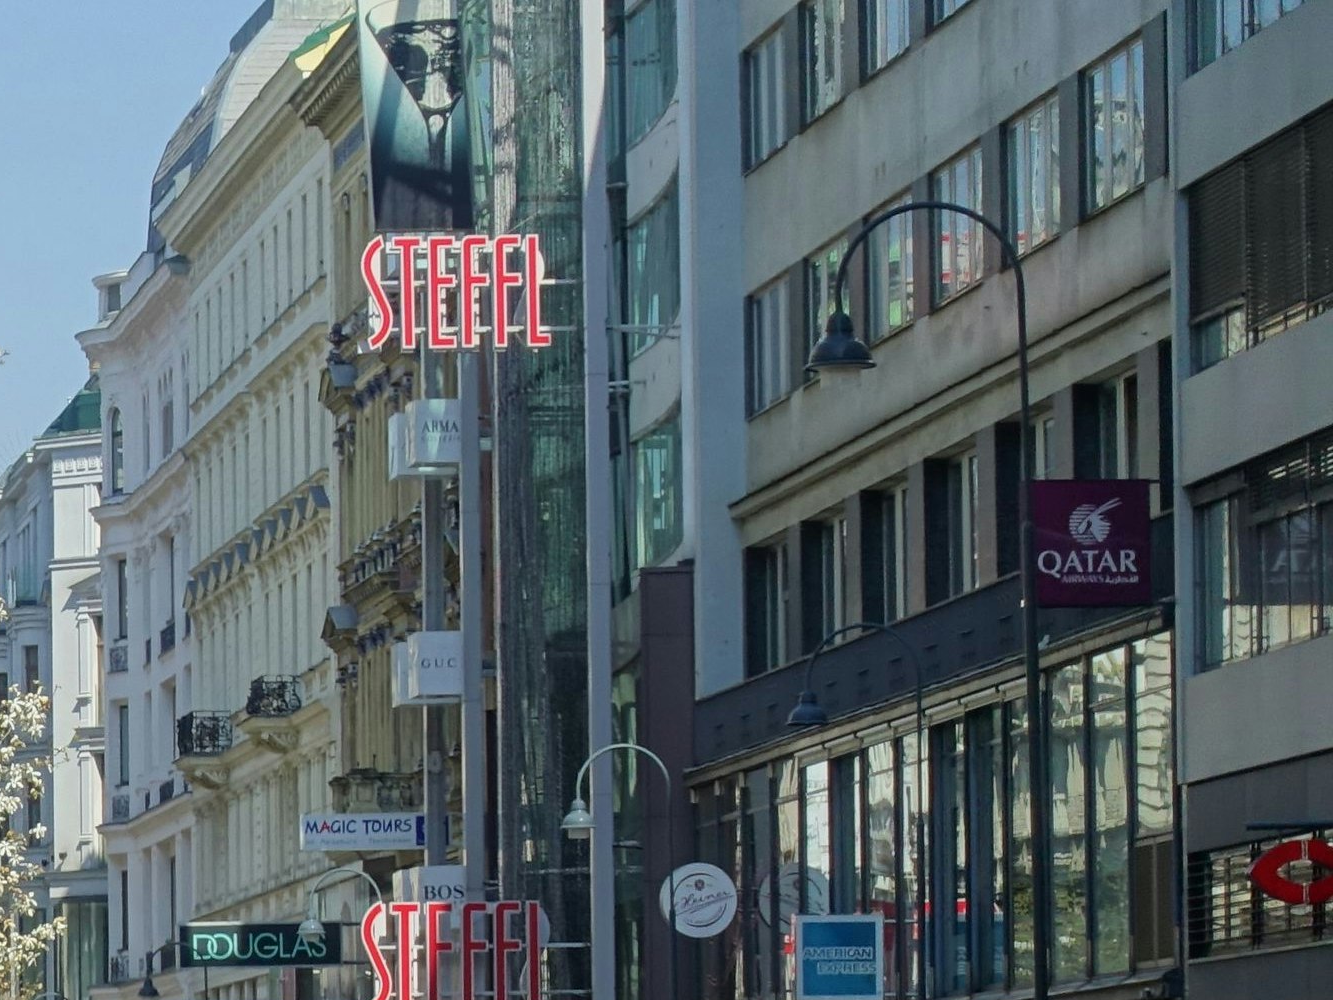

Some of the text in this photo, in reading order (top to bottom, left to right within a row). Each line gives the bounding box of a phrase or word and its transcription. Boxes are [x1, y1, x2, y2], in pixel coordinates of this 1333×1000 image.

[361, 234, 552, 350] STEFFL
[1037, 550, 1138, 579] QATAR
[305, 818, 412, 836] MAGIC TOURS
[192, 932, 327, 961] DOUGLAS
[804, 946, 873, 961] AMERICAN
[817, 961, 878, 975] EXPRESS
